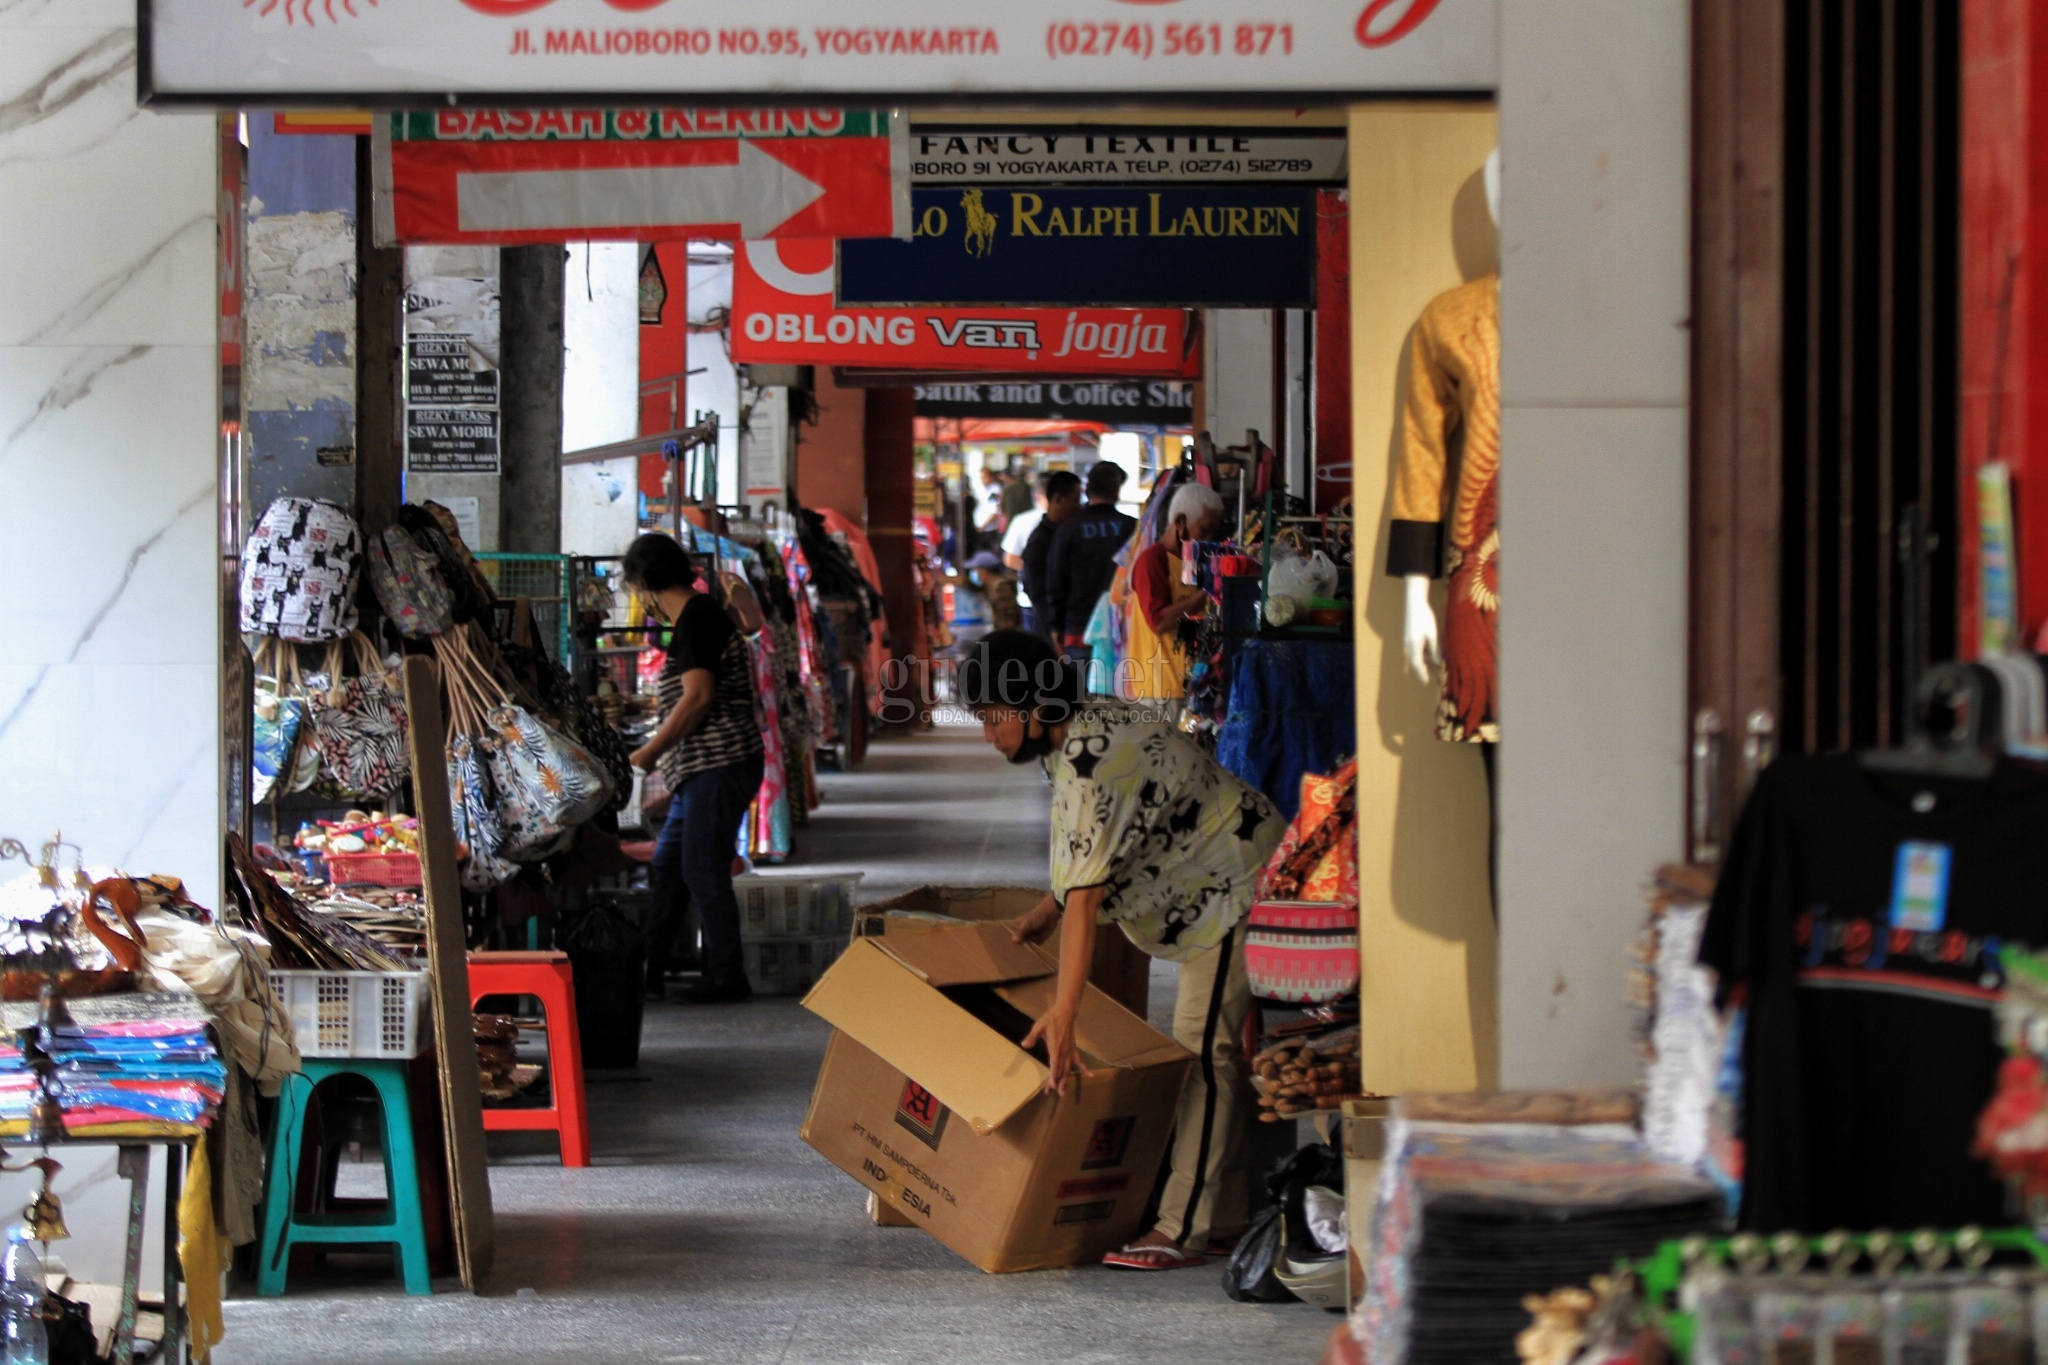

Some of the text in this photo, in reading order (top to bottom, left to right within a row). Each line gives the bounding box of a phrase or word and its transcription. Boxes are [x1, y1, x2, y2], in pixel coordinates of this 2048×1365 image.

[545, 29, 711, 55] MALIOBORO
[718, 29, 806, 58] NO.95,
[815, 28, 998, 55] YOGYAKARTA
[1046, 23, 1294, 60] (0274) 561 871
[435, 106, 603, 139] BASAH
[660, 106, 845, 137] KERING
[920, 136, 1250, 155] FANCY TEXTILE
[911, 159, 1312, 175] BORO 91 YOGYAKARTA TELP. (0274) 512789
[1011, 193, 1138, 237] RALPH
[1148, 193, 1301, 237] LAUREN
[744, 311, 1168, 359] OBLONG Van jogja
[410, 358, 449, 370] SEWA
[989, 384, 1042, 404] and
[1050, 383, 1140, 407] Coffee
[416, 410, 491, 421] RIZKY TRANS
[410, 426, 497, 438] SEWA MOBIL
[1081, 521, 1124, 539] DIY
[853, 1122, 866, 1138] PT
[866, 1134, 883, 1150] HM
[883, 1145, 941, 1195] SAMPOERNA
[863, 1158, 932, 1219] INDESIA
